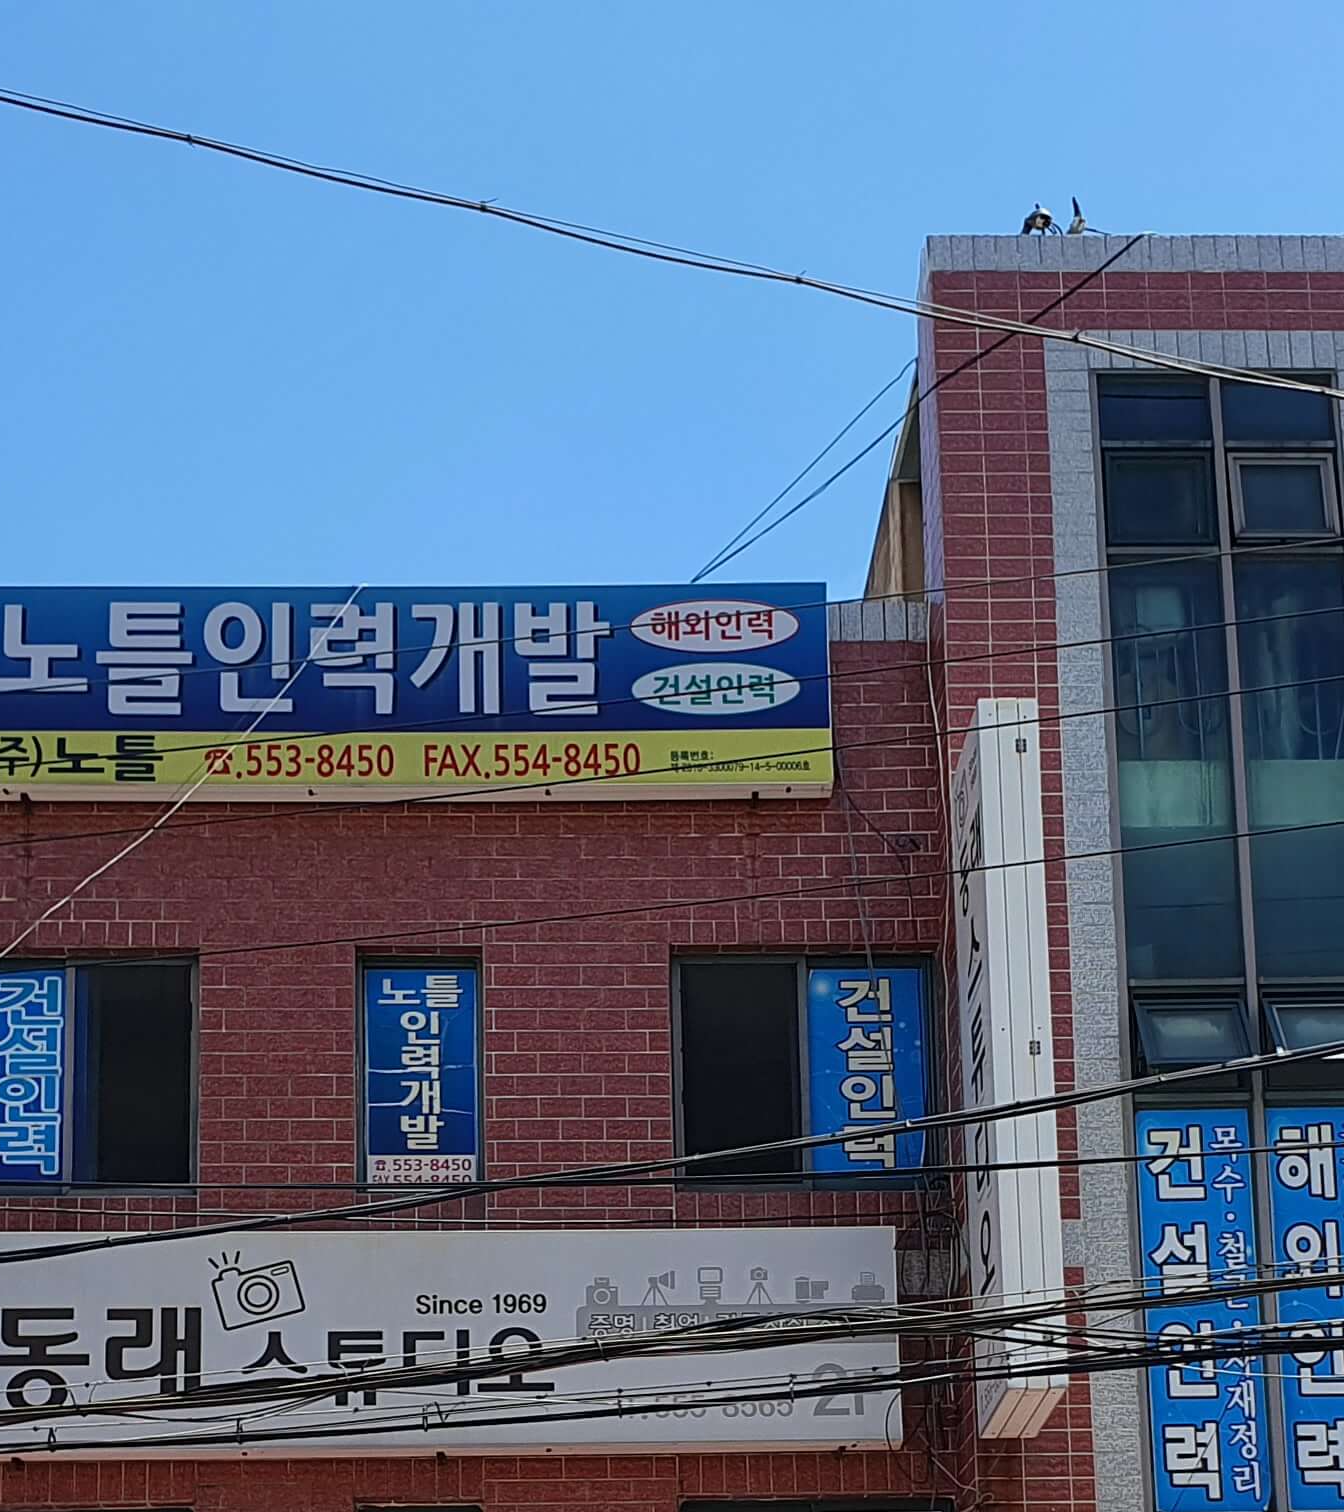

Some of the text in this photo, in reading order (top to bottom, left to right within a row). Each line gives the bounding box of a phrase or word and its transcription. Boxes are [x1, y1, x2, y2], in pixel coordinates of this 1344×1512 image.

[651, 610, 773, 641] 해외인력
[653, 673, 775, 705] 건설인력
[424, 743, 641, 779] FAX.554-8450
[837, 978, 896, 1168] 건설인력
[415, 1293, 547, 1316] Since 1969
[1146, 1125, 1222, 1501] 건설인력
[242, 1328, 555, 1408] 스튜디오
